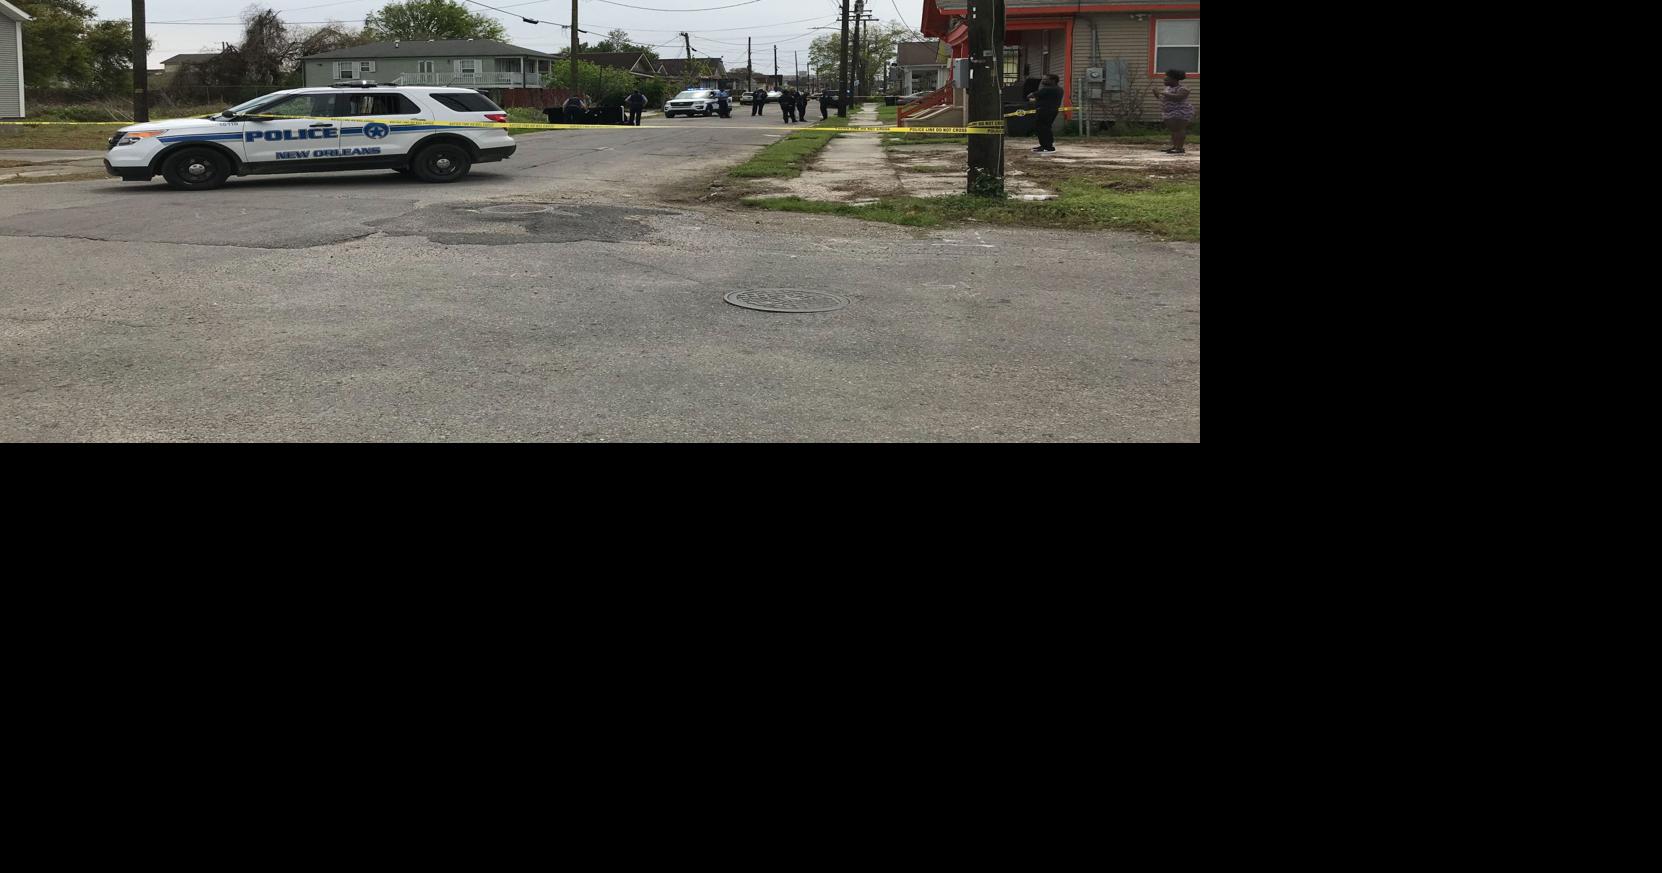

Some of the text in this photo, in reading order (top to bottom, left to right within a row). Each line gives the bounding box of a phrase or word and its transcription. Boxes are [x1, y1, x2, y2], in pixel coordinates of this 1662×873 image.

[245, 127, 339, 142] POLICE
[275, 147, 381, 160] NEW ORLEANS
